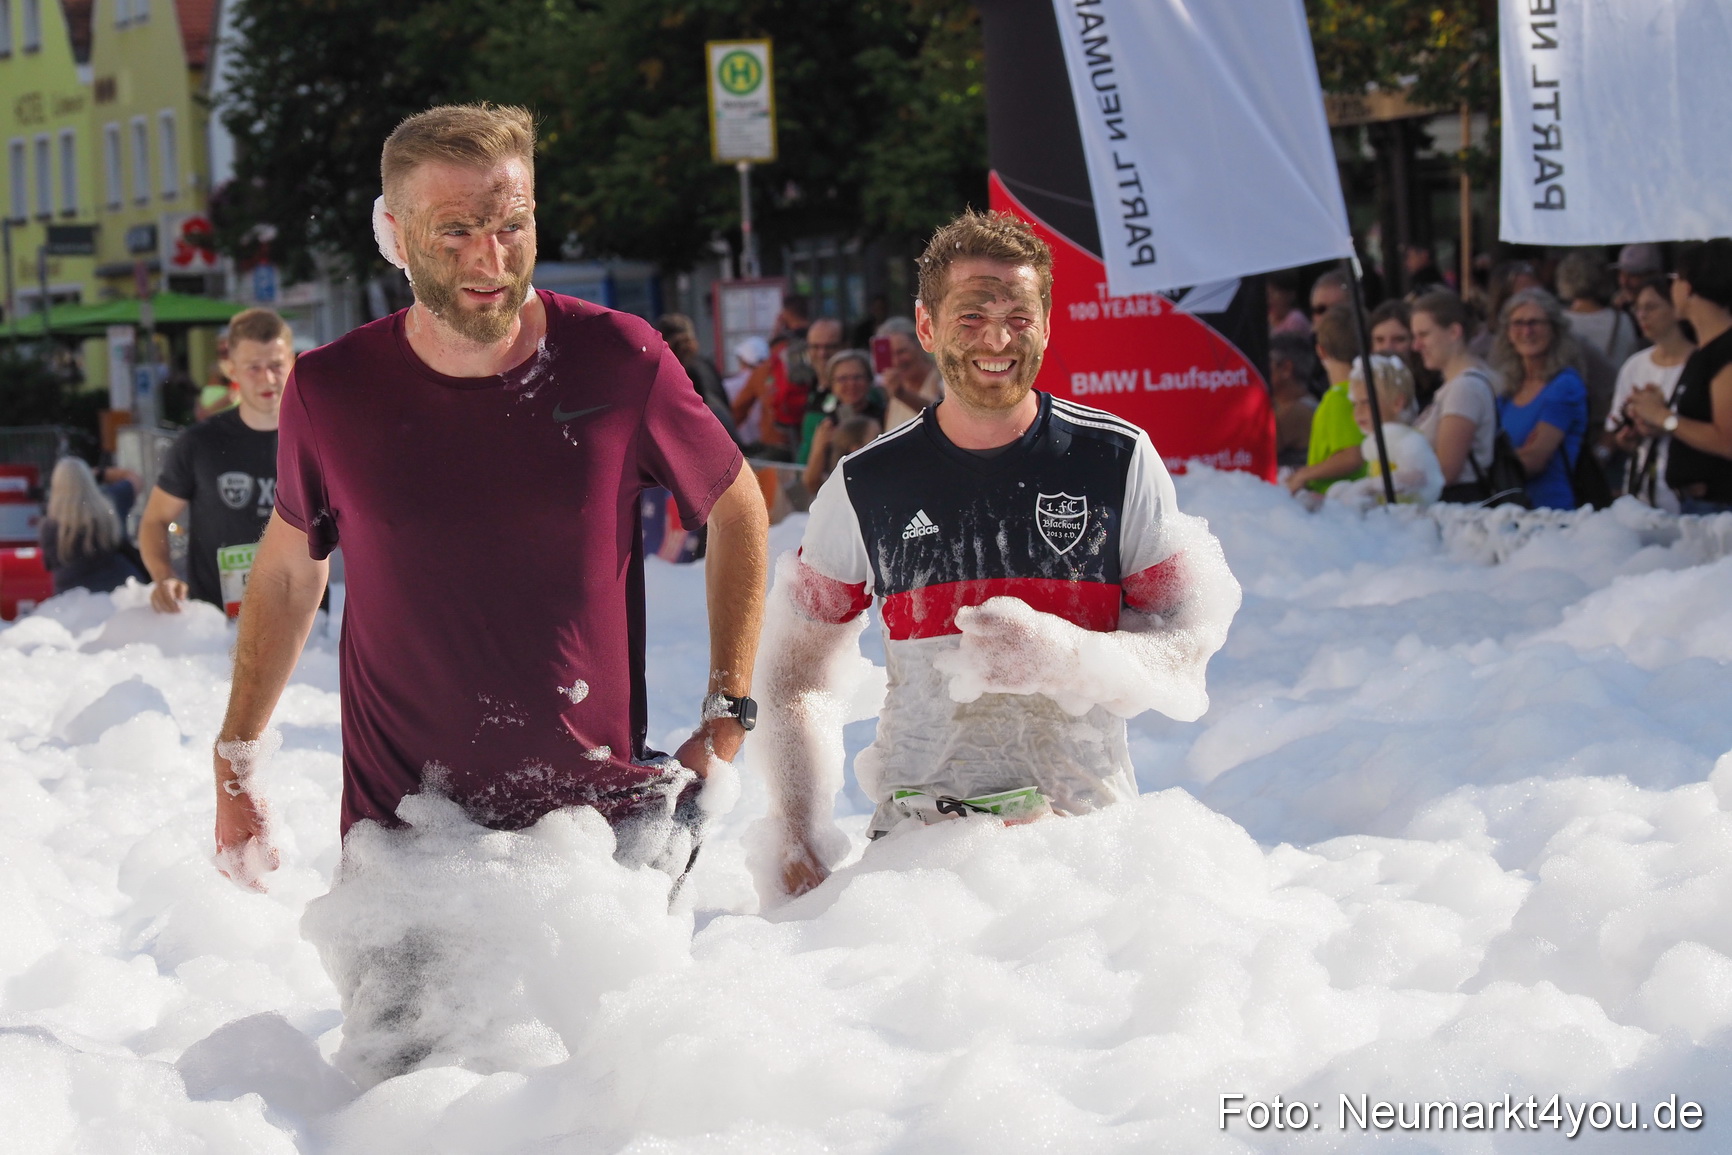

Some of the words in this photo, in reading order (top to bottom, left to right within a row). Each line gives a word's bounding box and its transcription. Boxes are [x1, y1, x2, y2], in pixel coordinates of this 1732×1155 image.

[1068, 302, 1099, 321] 100
[1101, 298, 1162, 318] YEARS
[1071, 369, 1138, 395] BMW
[1143, 366, 1249, 393] Laufsport
[902, 524, 939, 540] adidas
[1042, 519, 1081, 530] Blackout
[1046, 530, 1063, 539] 2013
